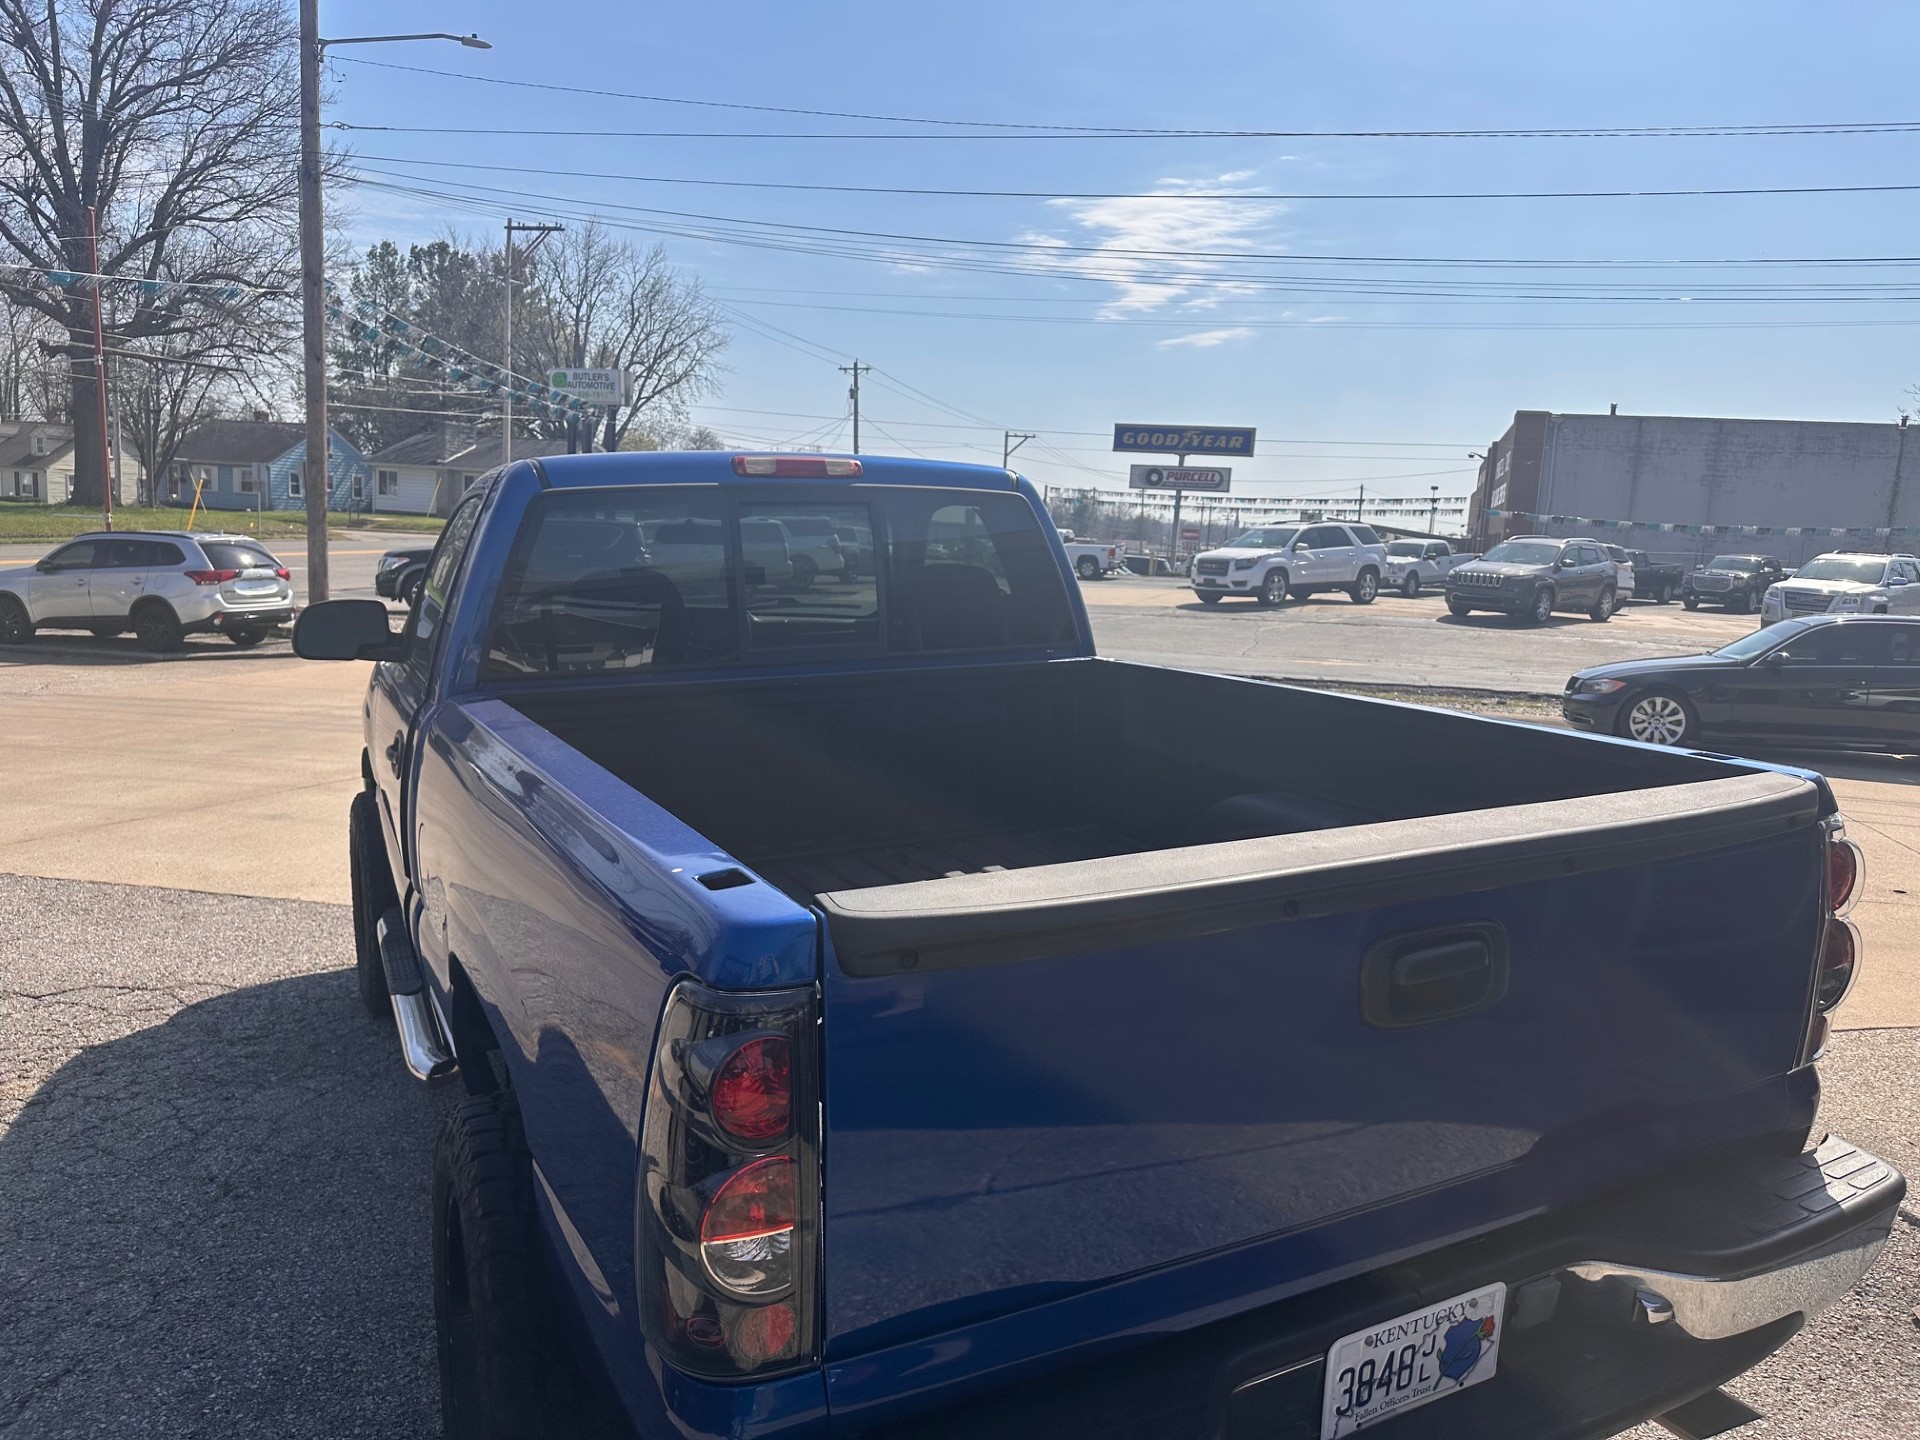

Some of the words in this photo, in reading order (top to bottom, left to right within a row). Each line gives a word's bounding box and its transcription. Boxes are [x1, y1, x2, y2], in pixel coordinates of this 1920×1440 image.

[573, 372, 609, 381] BUTLER'S
[567, 381, 615, 390] AUTOMOTIVE
[1122, 431, 1244, 448] GOODYEAR
[1166, 471, 1217, 482] PURCELL
[1373, 1300, 1470, 1349] KENTUCKY
[1335, 1343, 1416, 1416] 3848
[1354, 1407, 1378, 1422] Fallen
[1380, 1394, 1410, 1411] Officers
[1411, 1384, 1432, 1398] Trust
